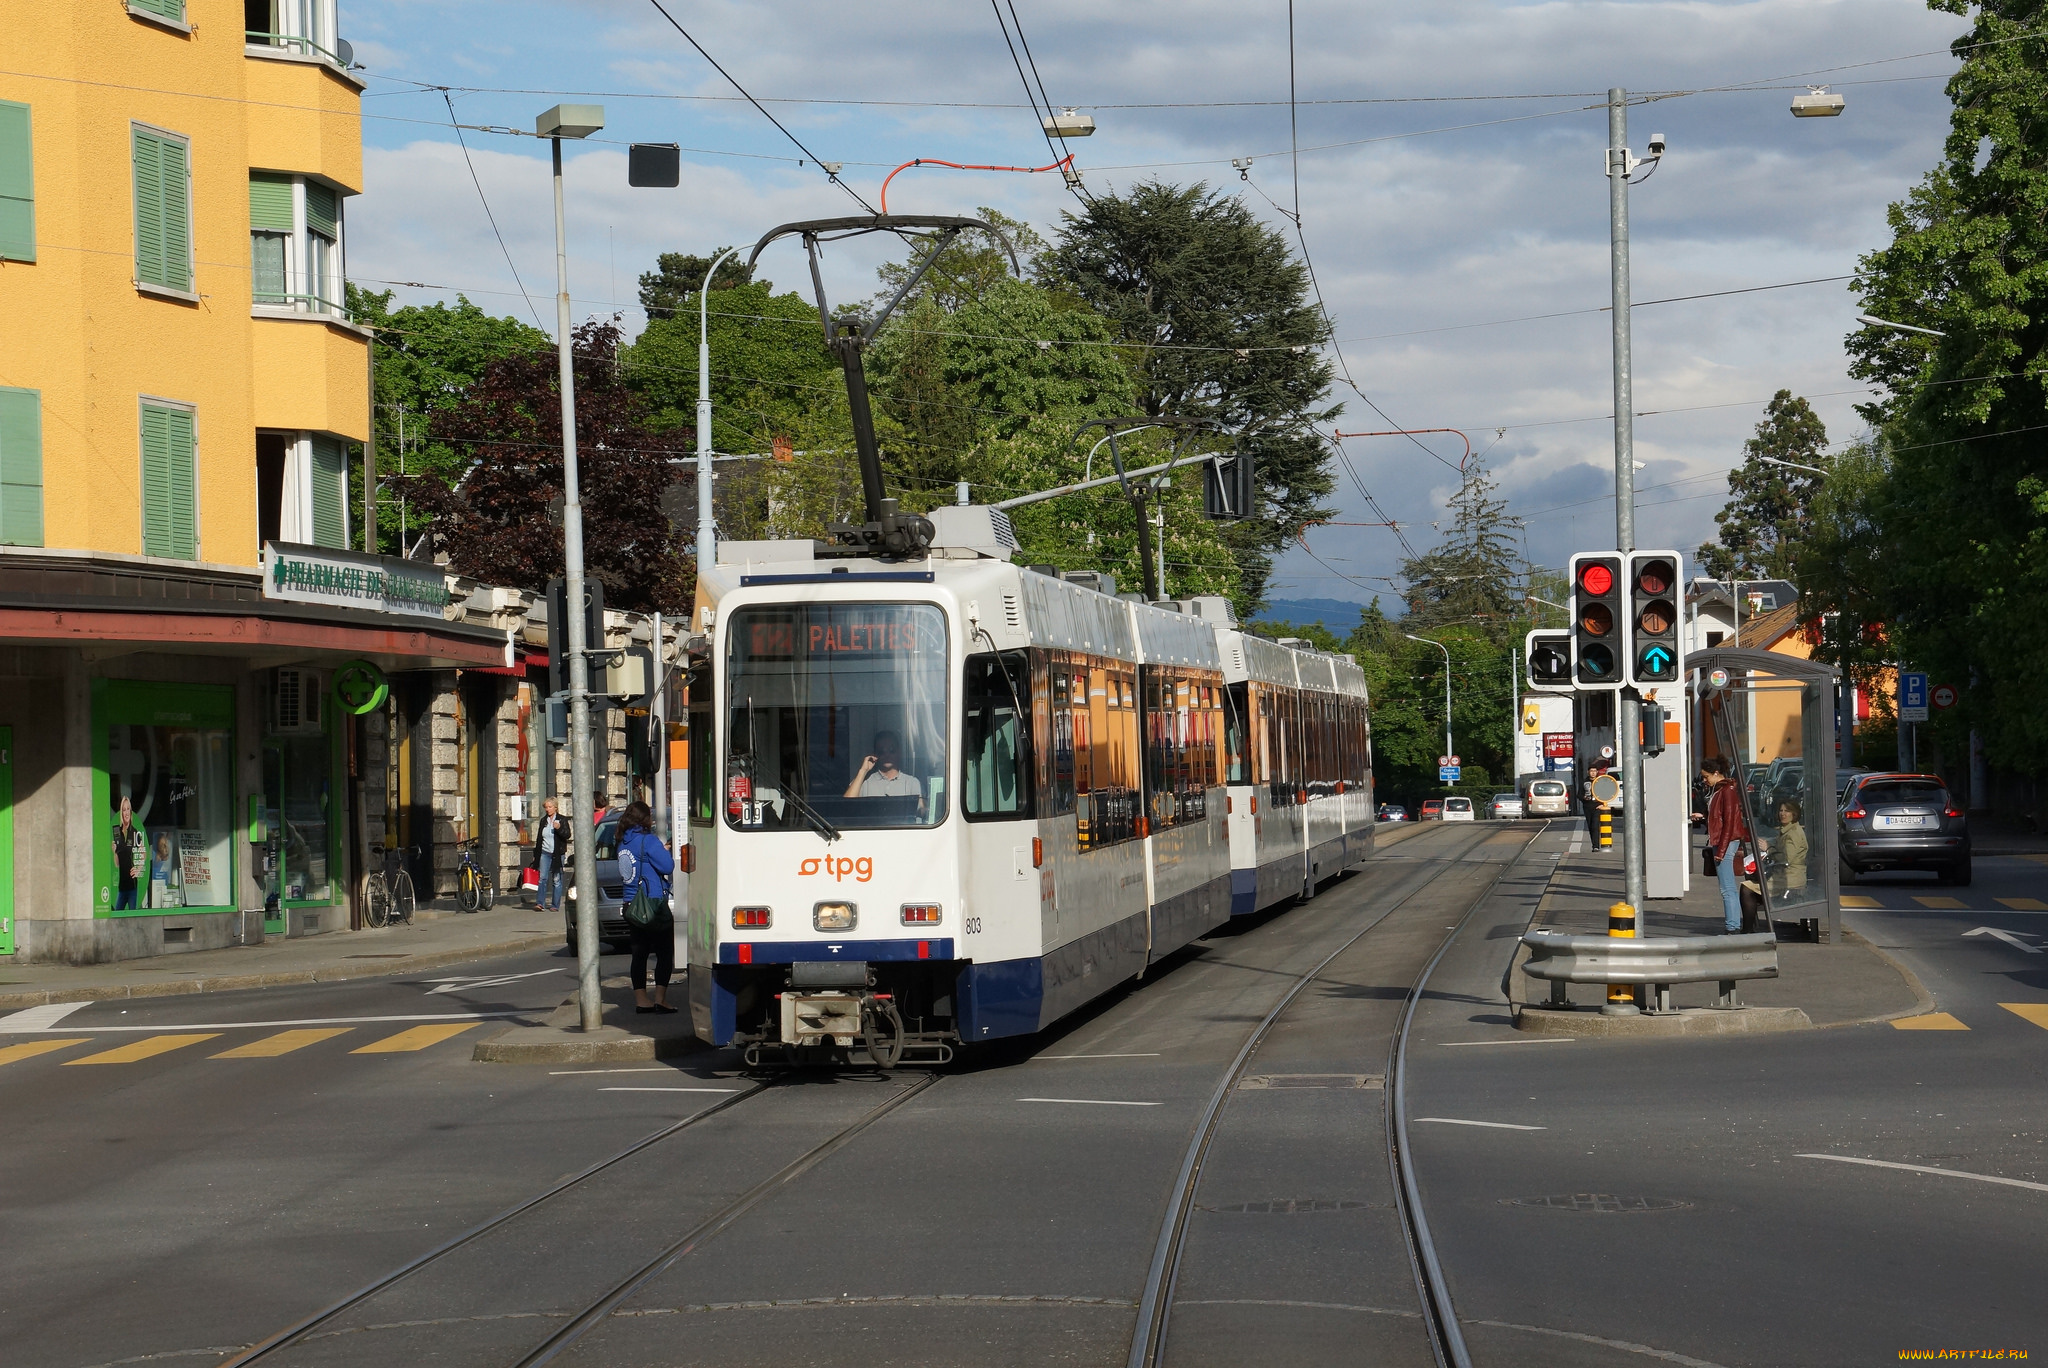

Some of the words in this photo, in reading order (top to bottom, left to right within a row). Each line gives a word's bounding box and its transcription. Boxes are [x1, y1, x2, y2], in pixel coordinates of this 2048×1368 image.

[288, 561, 364, 592] PHARMACIE
[366, 571, 383, 594] DE
[809, 623, 915, 651] PALETTES
[1909, 677, 1920, 692] P
[133, 831, 145, 847] ICI
[825, 853, 873, 882] tpg
[965, 917, 982, 934] 803
